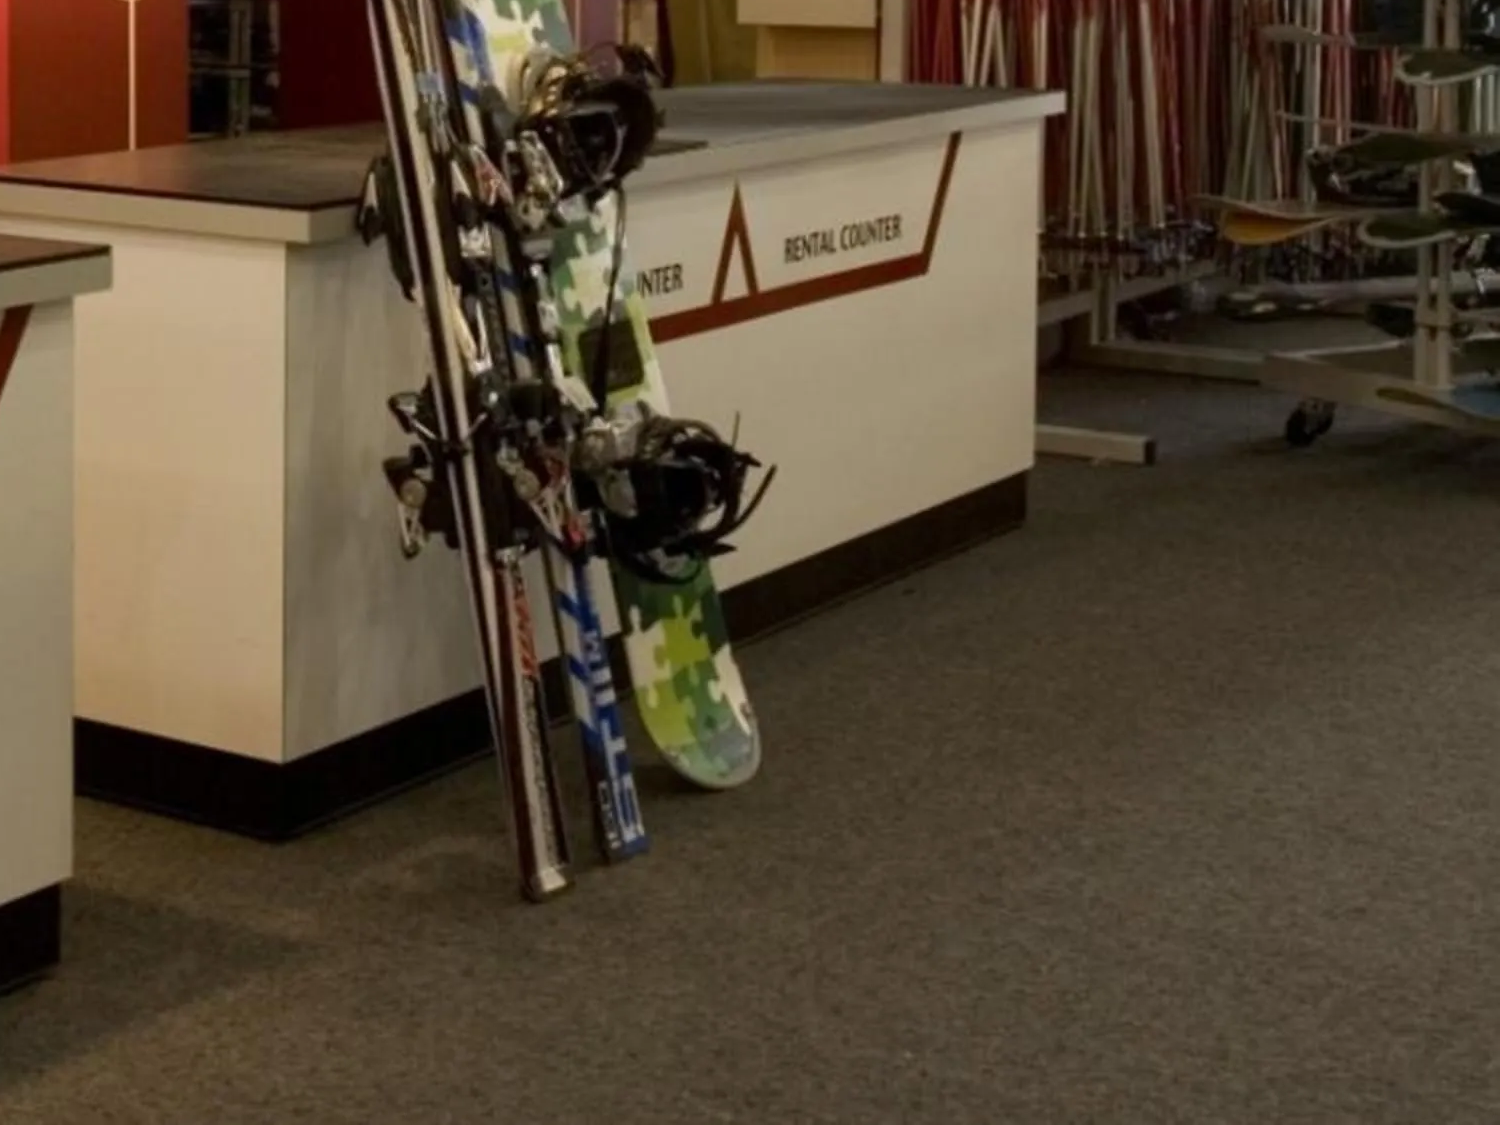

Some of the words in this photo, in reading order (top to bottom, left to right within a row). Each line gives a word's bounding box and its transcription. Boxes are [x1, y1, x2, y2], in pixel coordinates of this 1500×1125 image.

[784, 227, 838, 264] RENTAL
[839, 214, 902, 252] COUNTER
[636, 264, 684, 298] NTER
